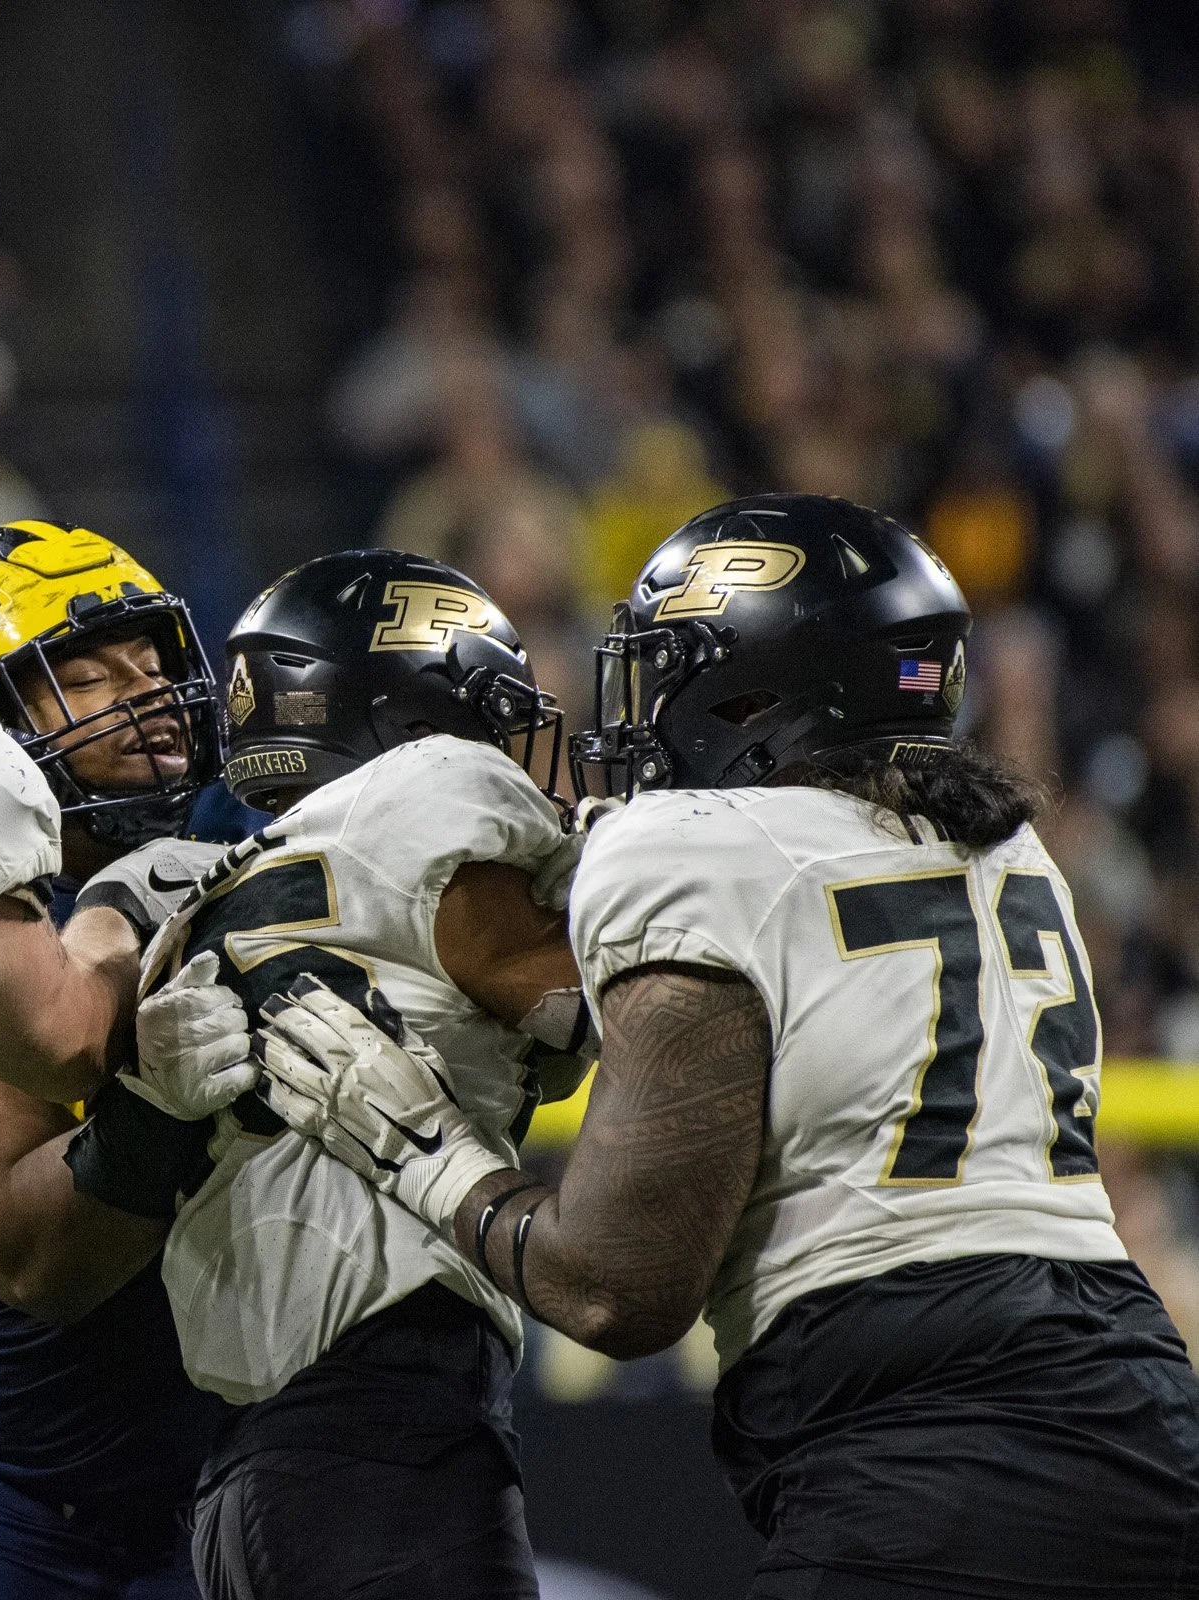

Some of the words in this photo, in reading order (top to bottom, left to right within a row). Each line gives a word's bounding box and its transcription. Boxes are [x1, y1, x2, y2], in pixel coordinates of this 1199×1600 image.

[369, 581, 494, 652] P
[654, 541, 806, 621] P
[824, 867, 1102, 1187] 72
